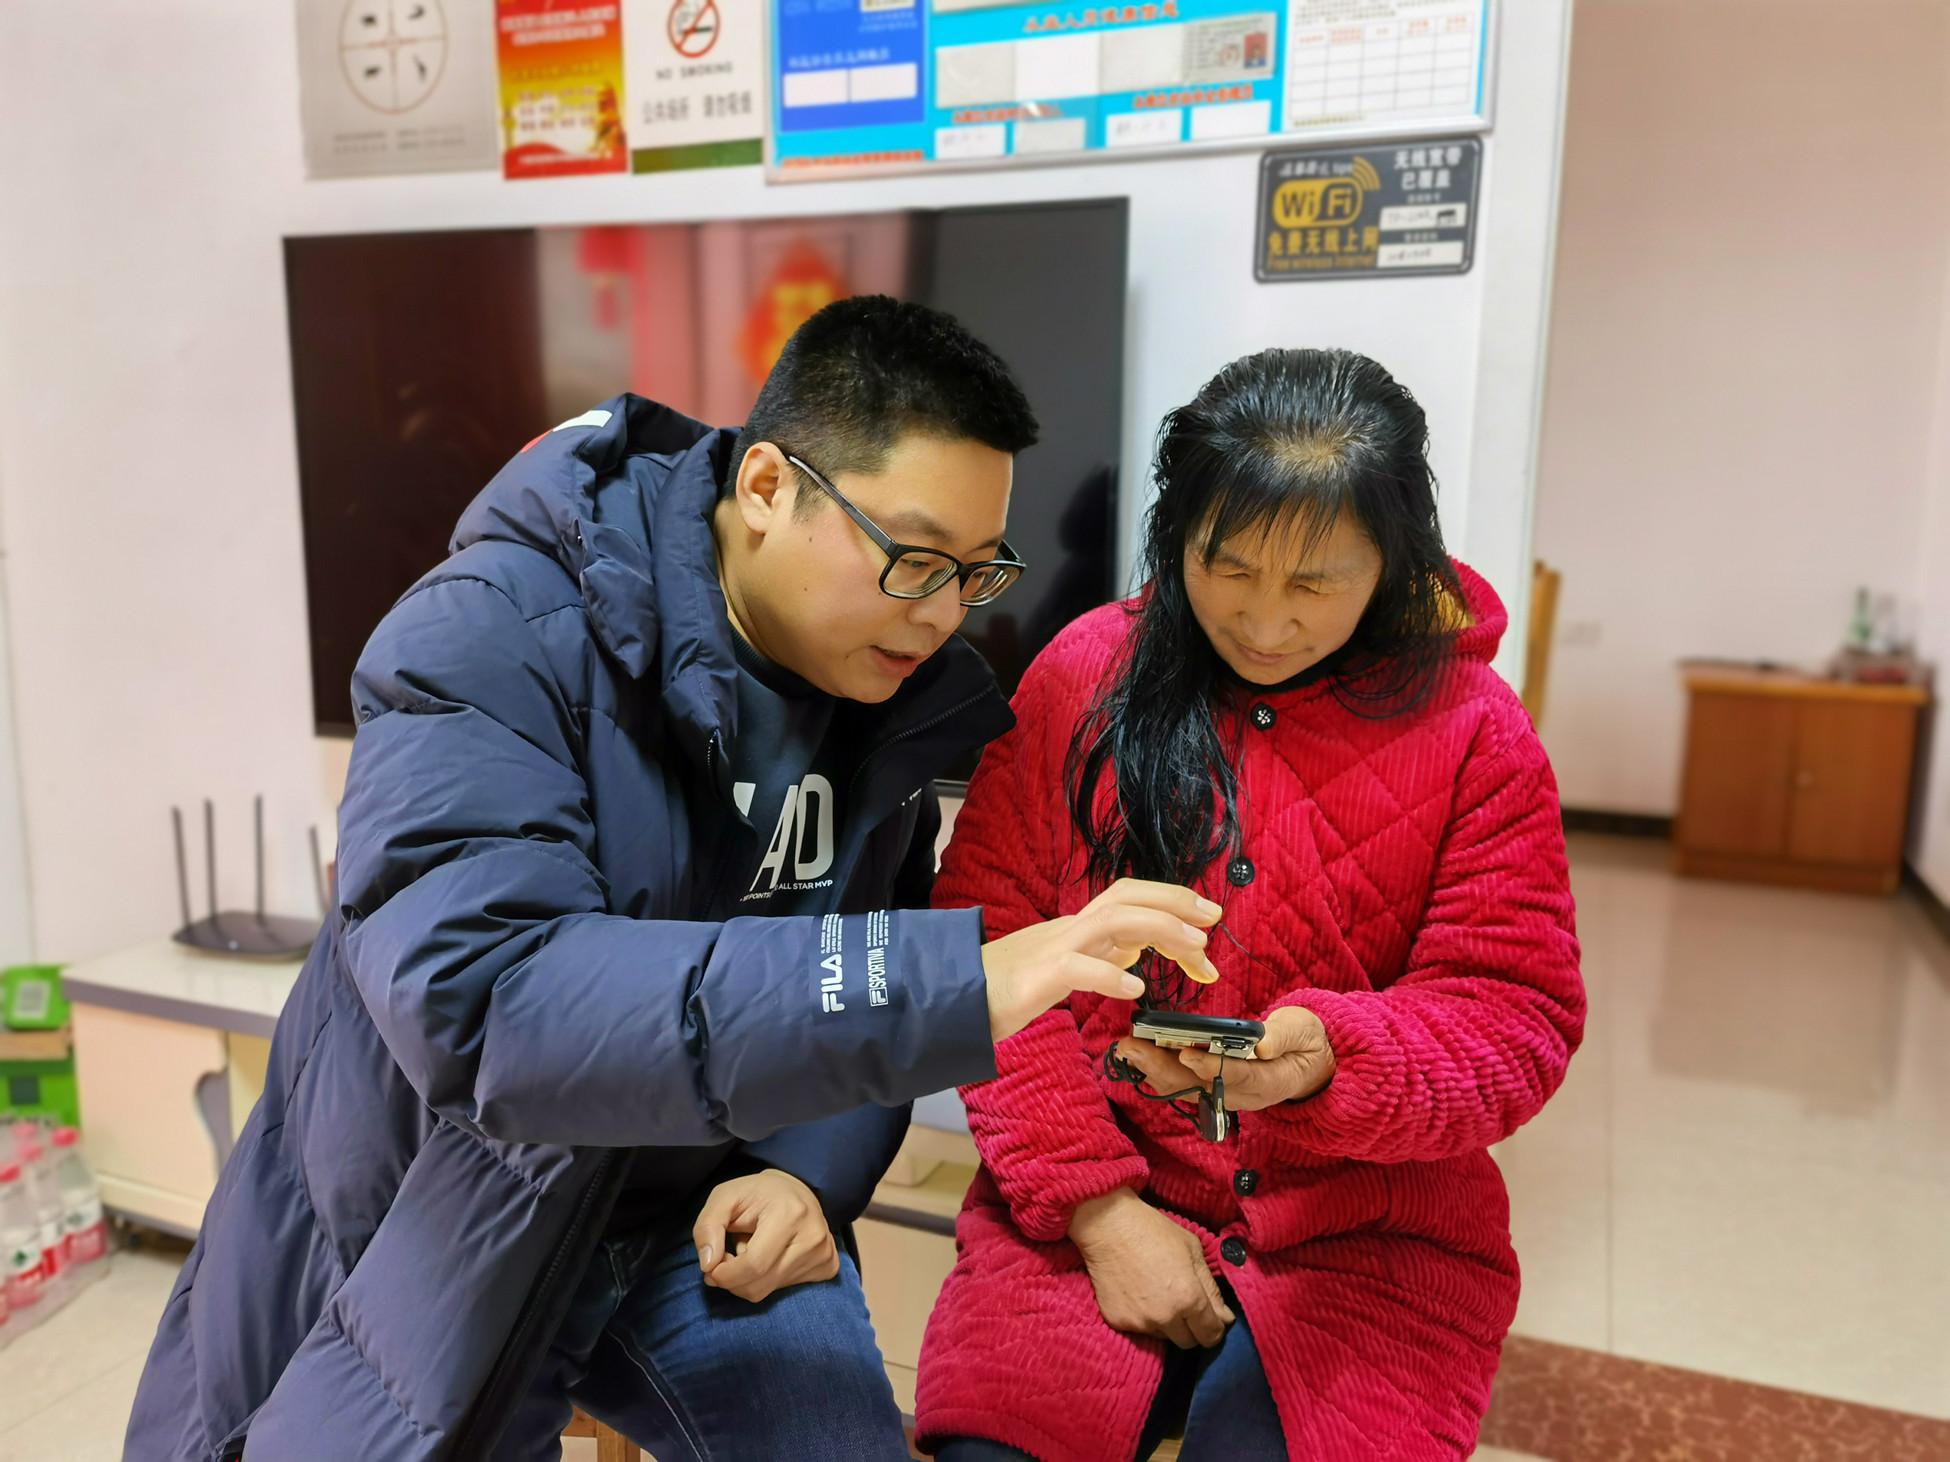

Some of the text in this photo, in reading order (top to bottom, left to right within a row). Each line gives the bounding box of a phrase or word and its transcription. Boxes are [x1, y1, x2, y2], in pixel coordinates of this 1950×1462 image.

[656, 62, 732, 79] NO SMOKING
[1269, 227, 1378, 256] 免费无线上网
[778, 882, 792, 890] ALL
[793, 882, 814, 890] STAR
[815, 879, 833, 888] MVP
[867, 947, 886, 988] SPORTIVA
[821, 953, 845, 1013] FILA
